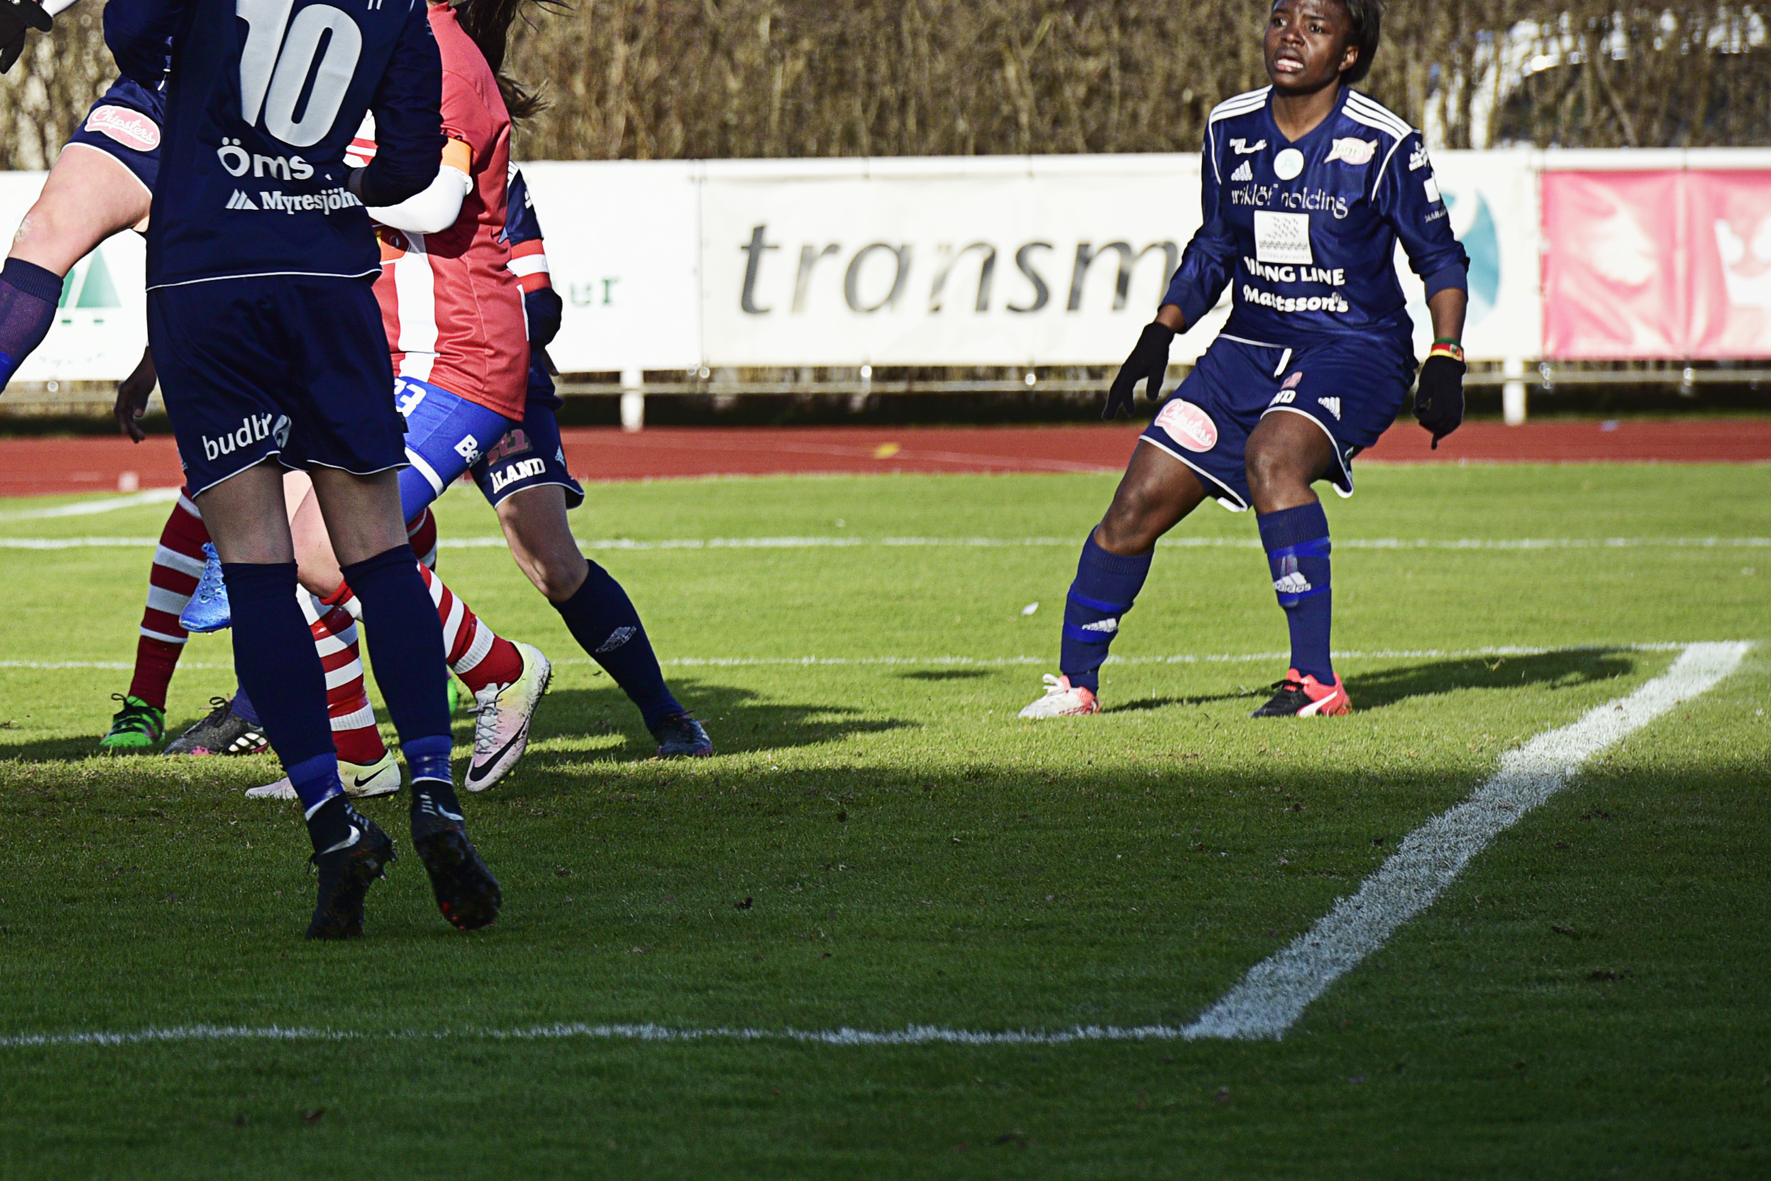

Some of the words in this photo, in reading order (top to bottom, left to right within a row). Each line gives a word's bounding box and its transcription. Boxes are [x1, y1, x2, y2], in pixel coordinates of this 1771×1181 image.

[91, 107, 157, 147] Chipsters
[216, 135, 315, 181] Öms
[1299, 265, 1346, 286] LINE
[489, 457, 546, 495] ÅLAND
